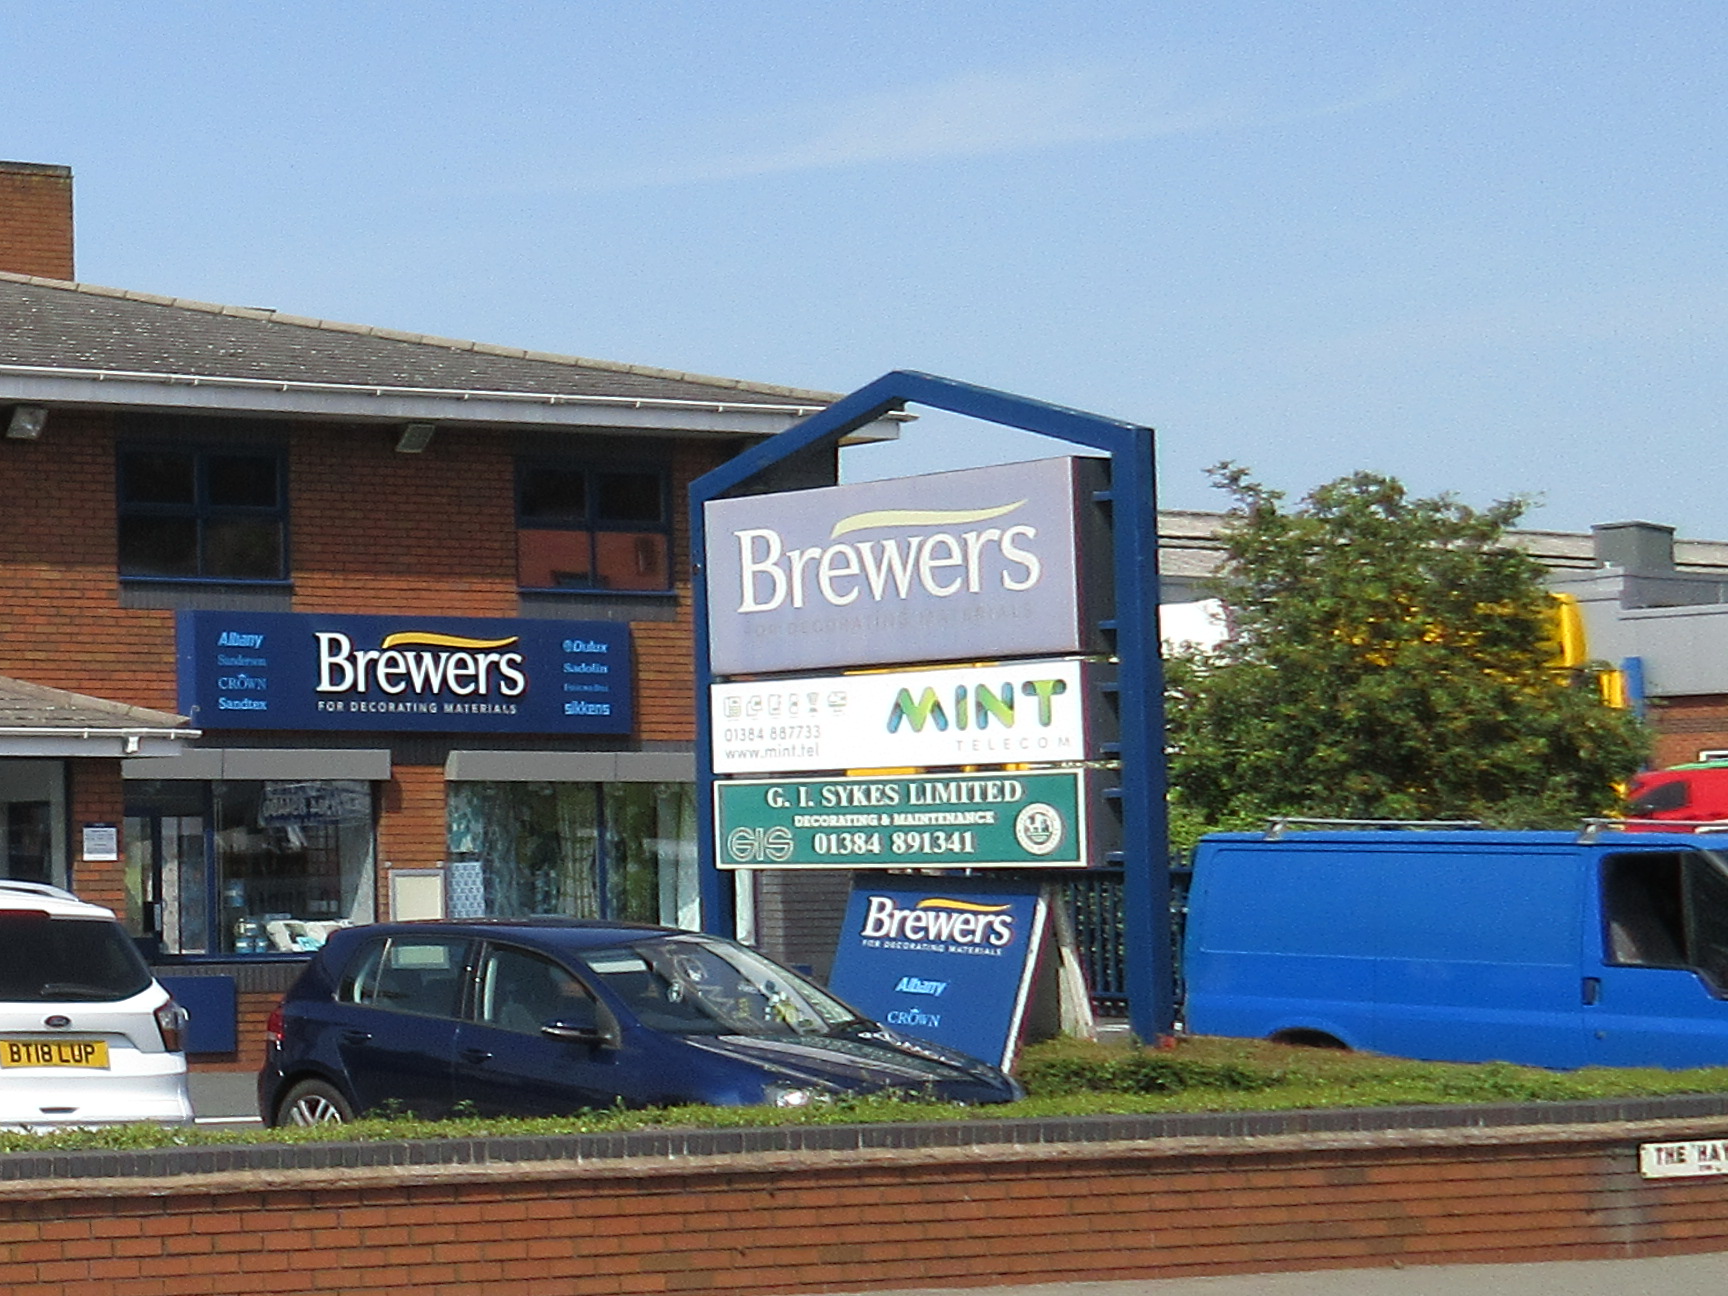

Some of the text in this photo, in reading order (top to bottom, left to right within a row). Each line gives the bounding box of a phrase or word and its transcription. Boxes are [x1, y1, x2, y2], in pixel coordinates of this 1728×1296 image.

[733, 525, 1041, 613] Brewers
[217, 631, 264, 648] Albany
[315, 632, 526, 697] Brewers
[217, 676, 268, 690] CROWN
[217, 697, 268, 710] Sandtex
[318, 701, 518, 715] FOR DECORATING MATERIALS
[886, 678, 1067, 734] MINT
[724, 724, 821, 742] 01384 887733
[724, 742, 819, 758] www.mint.tel
[956, 735, 1071, 752] TELECOM
[821, 782, 902, 807] SYKES
[908, 779, 1023, 804] LIMITED
[793, 810, 995, 827] DECORATING & MAINTENANCE
[727, 826, 794, 861] GIS
[813, 830, 974, 855] 01384 891341
[860, 895, 1014, 946] Brewers
[862, 938, 1003, 956] FOR DECORATING MATERIALS
[894, 976, 948, 997] Albany
[887, 1010, 941, 1028] CROWN
[9, 1043, 95, 1064] BT18 LUP
[1655, 1146, 1686, 1166] THE
